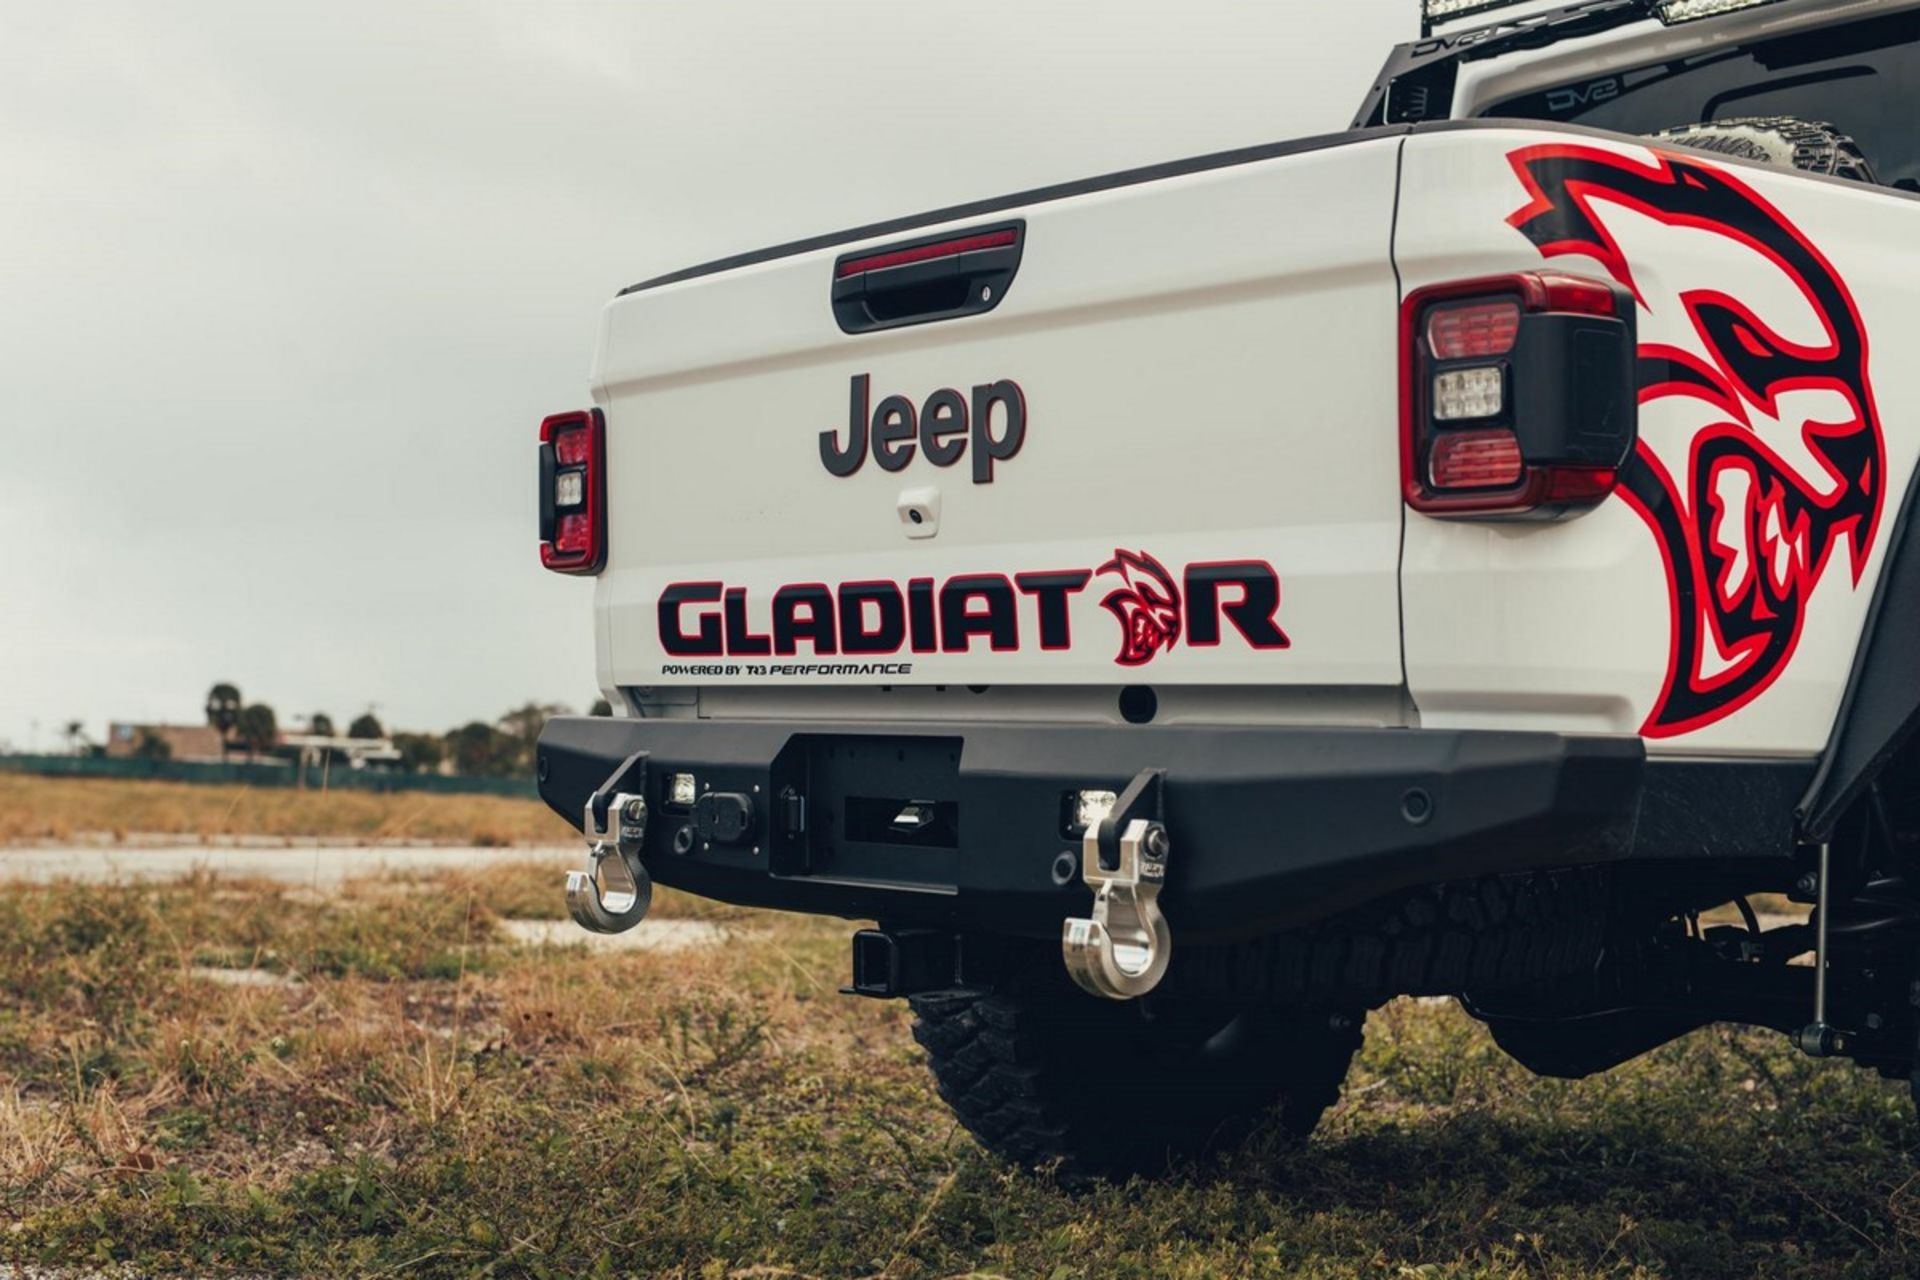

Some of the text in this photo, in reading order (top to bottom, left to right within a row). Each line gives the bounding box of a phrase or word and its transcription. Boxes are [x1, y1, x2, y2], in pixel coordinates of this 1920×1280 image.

[819, 373, 1027, 484] Jeep
[657, 559, 1291, 656] GLADIATR
[661, 664, 723, 676] POWERED
[725, 664, 742, 675] BY
[769, 663, 913, 676] PERFORMANCE
